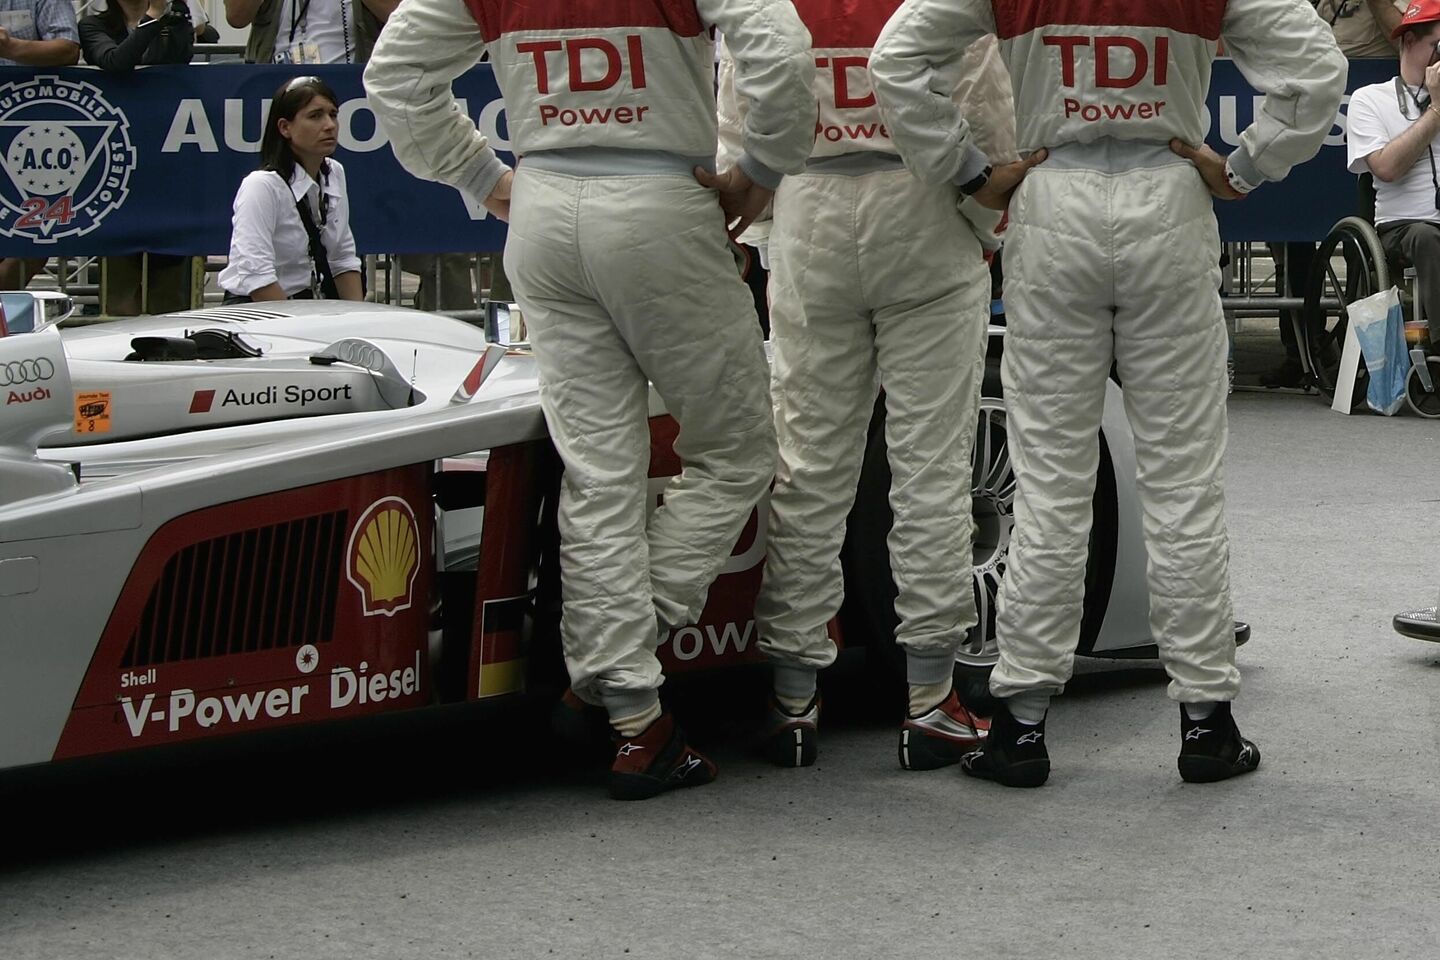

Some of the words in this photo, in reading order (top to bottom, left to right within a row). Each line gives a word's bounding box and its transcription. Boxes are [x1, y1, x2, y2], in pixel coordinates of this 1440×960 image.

[517, 35, 647, 95] TDI
[1043, 37, 1169, 89] TDI
[0, 86, 106, 117] UTOMOBILE
[540, 103, 649, 126] Power
[1064, 98, 1166, 123] Power
[85, 141, 125, 217] L'OUEST
[14, 195, 77, 229] 24
[5, 386, 52, 407] Audi
[221, 385, 277, 407] Audi
[284, 383, 352, 407] Sport
[121, 669, 156, 688] Shell
[121, 683, 309, 737] V-Power
[330, 650, 420, 709] Diesel
